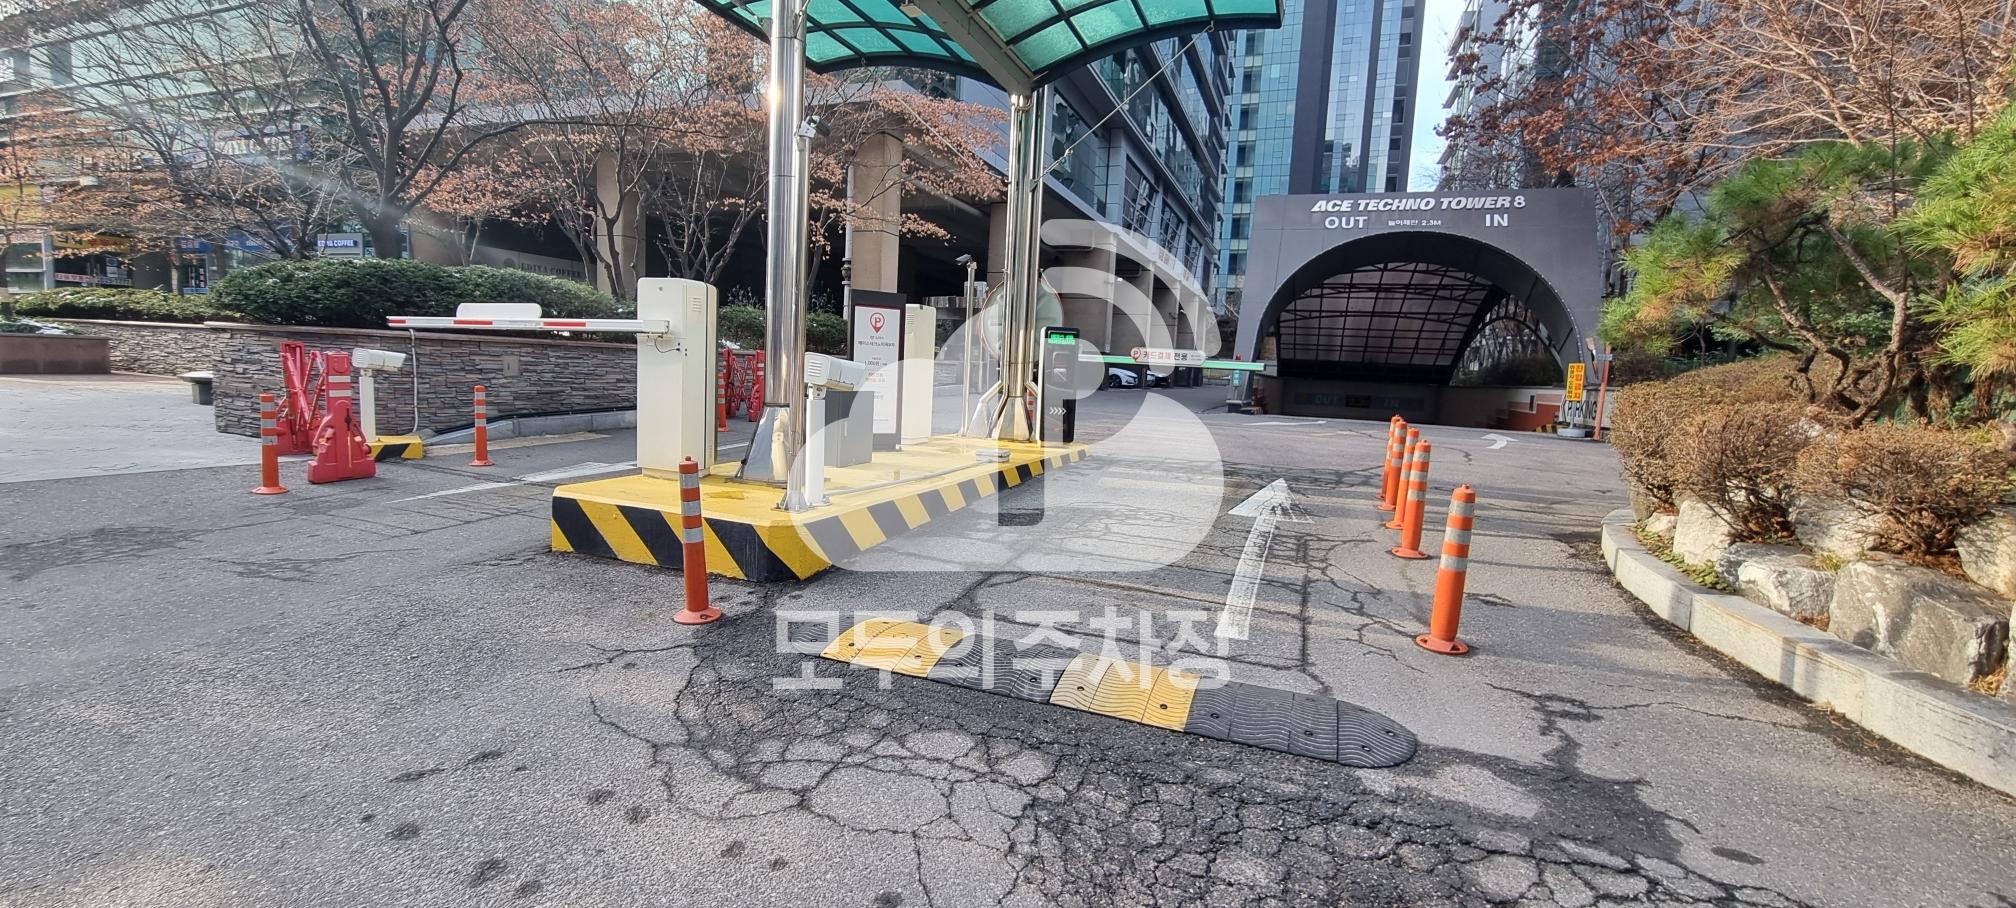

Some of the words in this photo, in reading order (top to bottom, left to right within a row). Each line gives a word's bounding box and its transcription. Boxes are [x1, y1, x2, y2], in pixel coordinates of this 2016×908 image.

[1311, 199, 1354, 212] ACE
[1358, 198, 1436, 211] TECHNO
[1440, 196, 1512, 210] TOWER
[1513, 196, 1526, 208] 8
[1324, 216, 1368, 229] OUT
[1485, 214, 1509, 227] IN
[1174, 352, 1188, 361] 전용
